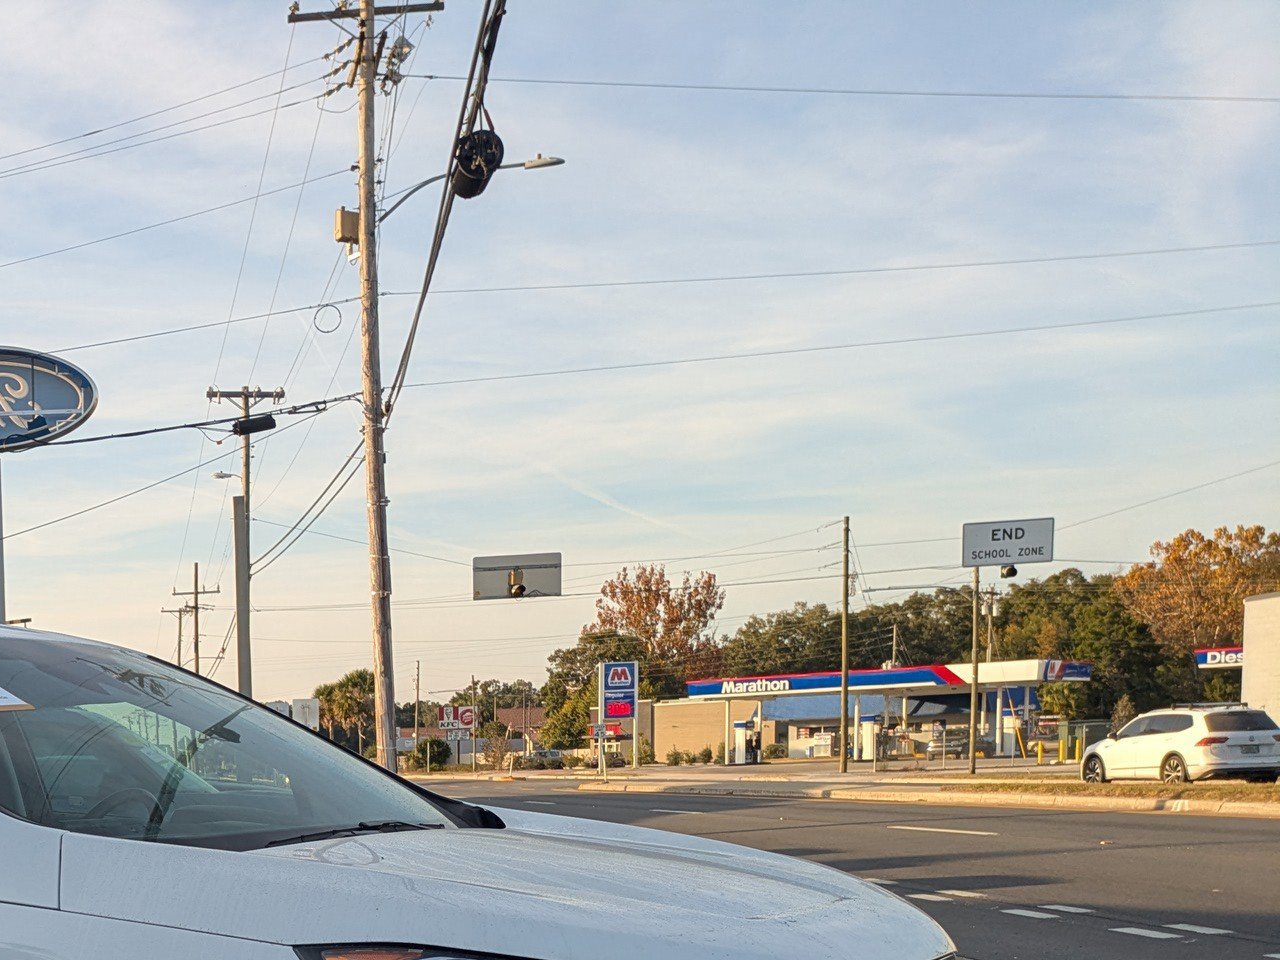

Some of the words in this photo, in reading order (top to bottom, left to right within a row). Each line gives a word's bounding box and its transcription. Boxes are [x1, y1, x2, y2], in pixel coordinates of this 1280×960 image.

[991, 528, 1025, 541] END
[972, 549, 1011, 559] SCHOOL
[1018, 547, 1044, 556] ZONE
[1207, 651, 1244, 664] Dies
[721, 679, 790, 694] Marathon
